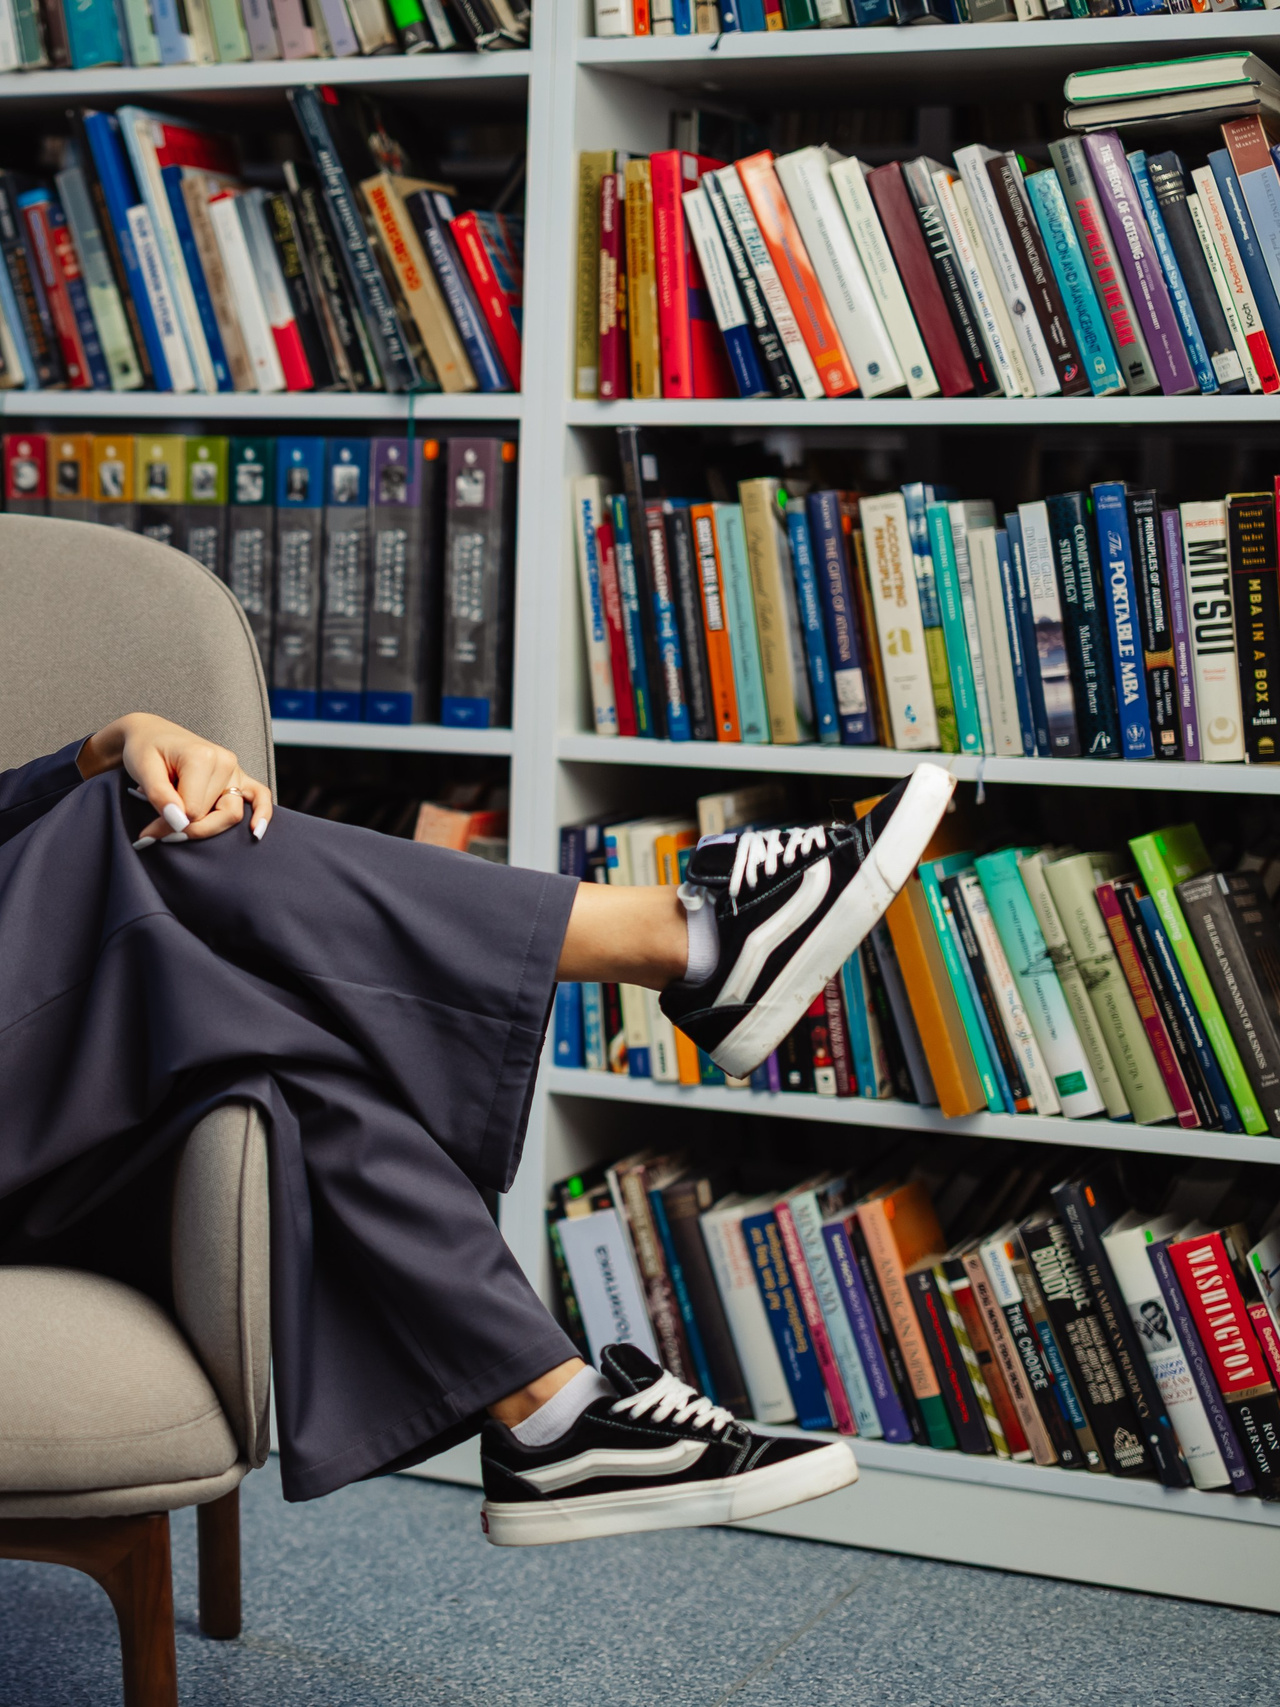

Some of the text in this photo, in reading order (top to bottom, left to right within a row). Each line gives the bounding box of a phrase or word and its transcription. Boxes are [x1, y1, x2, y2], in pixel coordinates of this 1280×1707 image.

[1234, 132, 1256, 142] BOWEN
[1235, 138, 1260, 149] MAKENS
[1098, 143, 1145, 260] THE THEORY OF CATERING
[1140, 178, 1151, 197] How
[1260, 171, 1279, 217] MARKETING
[332, 195, 361, 252] Russian
[745, 226, 768, 268] TRADE
[919, 204, 950, 259] MITI
[1201, 178, 1244, 293] Arbeitnehmer steuern mit
[353, 250, 370, 272] the
[1061, 258, 1079, 282] AND
[1075, 196, 1136, 346] PROPHETS IN THE DARK
[742, 277, 769, 328] Planning
[1068, 282, 1100, 351] MANAGEMENT
[1241, 303, 1255, 327] Koch
[1185, 518, 1225, 529] ROBERTS
[1239, 521, 1265, 530] Ideas from
[1240, 509, 1263, 517] Practical
[823, 536, 838, 559] THE
[873, 526, 893, 598] PRINCIPLES
[886, 515, 907, 606] ACCOUNTING
[1058, 538, 1078, 604] STRATEGY
[1072, 524, 1096, 610] COMPETITIVE
[1144, 515, 1164, 631] PRINCIPLES OF AUDITING
[826, 560, 843, 595] GIFTS
[1187, 539, 1234, 655] MITSUI
[831, 595, 844, 613] OF
[1108, 531, 1140, 705] The PORTABLE MBA
[1247, 578, 1269, 702] MBA IN A BOX
[1078, 624, 1100, 714] Michael E. Porter
[1156, 889, 1184, 940] Designing
[1202, 913, 1216, 931] THE
[1209, 930, 1226, 958] LEGAL
[1219, 958, 1247, 1017] ENVIRONMENT
[1240, 1015, 1253, 1030] OF
[1245, 1030, 1267, 1068] BUSINESS
[1030, 1247, 1069, 1304] BUNDY
[880, 1254, 931, 1391] AMERICAN EMPIRE
[1005, 1304, 1028, 1336] THE
[1187, 1245, 1255, 1381] WASHINGTON
[1251, 1308, 1267, 1319] 122
[1016, 1335, 1049, 1390] CHOICE
[1085, 1347, 1100, 1370] ABOUT
[1086, 1263, 1149, 1417] THE AMERICAN PRESIDENCY
[1097, 1344, 1112, 1363] AND
[1177, 1314, 1235, 1459] Alternative Conceptions of Civil Society
[1240, 1406, 1271, 1475] CHERNOW
[1262, 1421, 1280, 1451] RON
